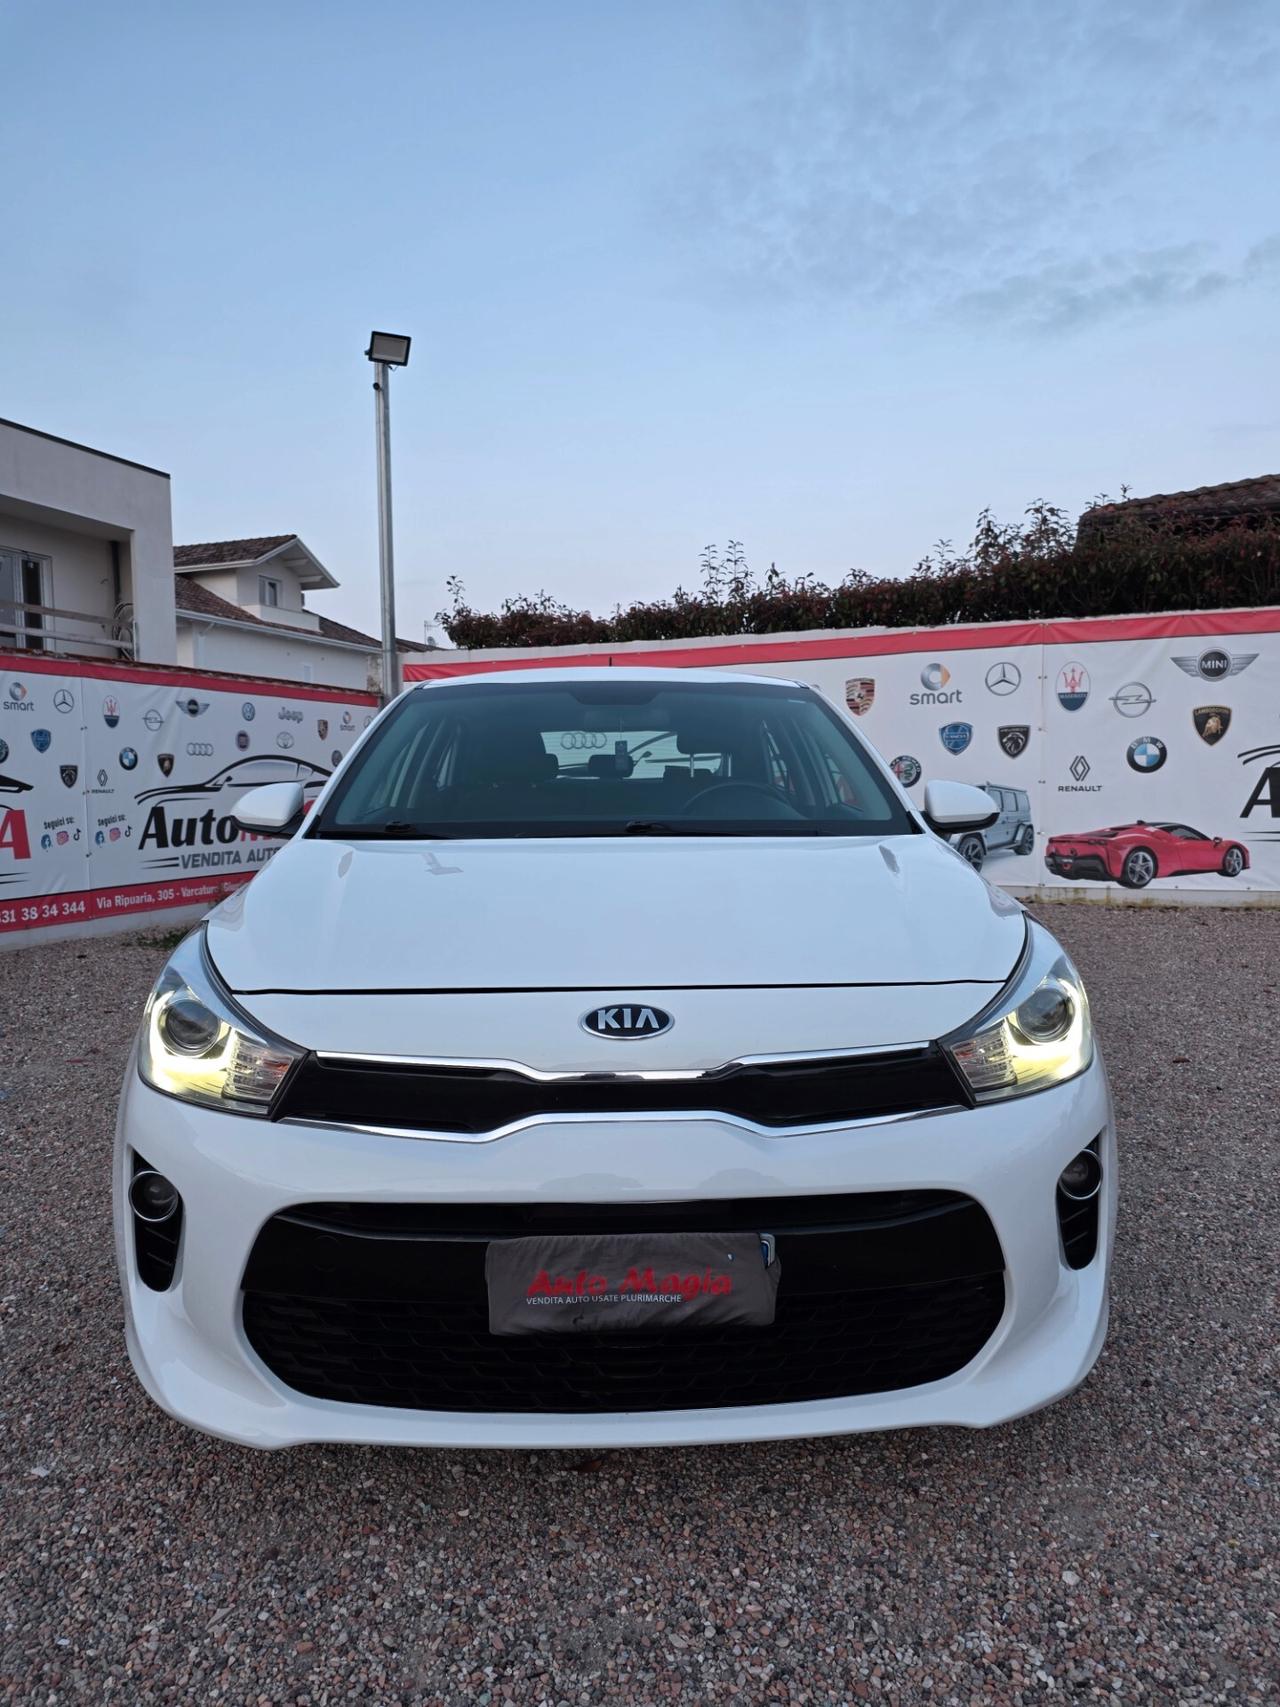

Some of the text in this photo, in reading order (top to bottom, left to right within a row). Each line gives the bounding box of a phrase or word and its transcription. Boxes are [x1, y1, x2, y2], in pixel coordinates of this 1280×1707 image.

[1200, 660, 1228, 669] MINI
[910, 689, 963, 706] smart
[3, 701, 35, 712] smart
[278, 706, 304, 724] Jeep
[1131, 736, 1164, 749] BMW
[1058, 785, 1103, 793] RENAULT
[181, 850, 242, 869] VENDITA
[96, 896, 112, 909] Via
[114, 892, 156, 908] Ripuaria,
[158, 888, 175, 901] 305
[0, 900, 86, 924] 31 38 34 344
[597, 1007, 660, 1030] KIA
[527, 1265, 733, 1301] Auto Magia
[526, 1294, 682, 1305] VENDITA AUTO USATE PLURIMARCHE
